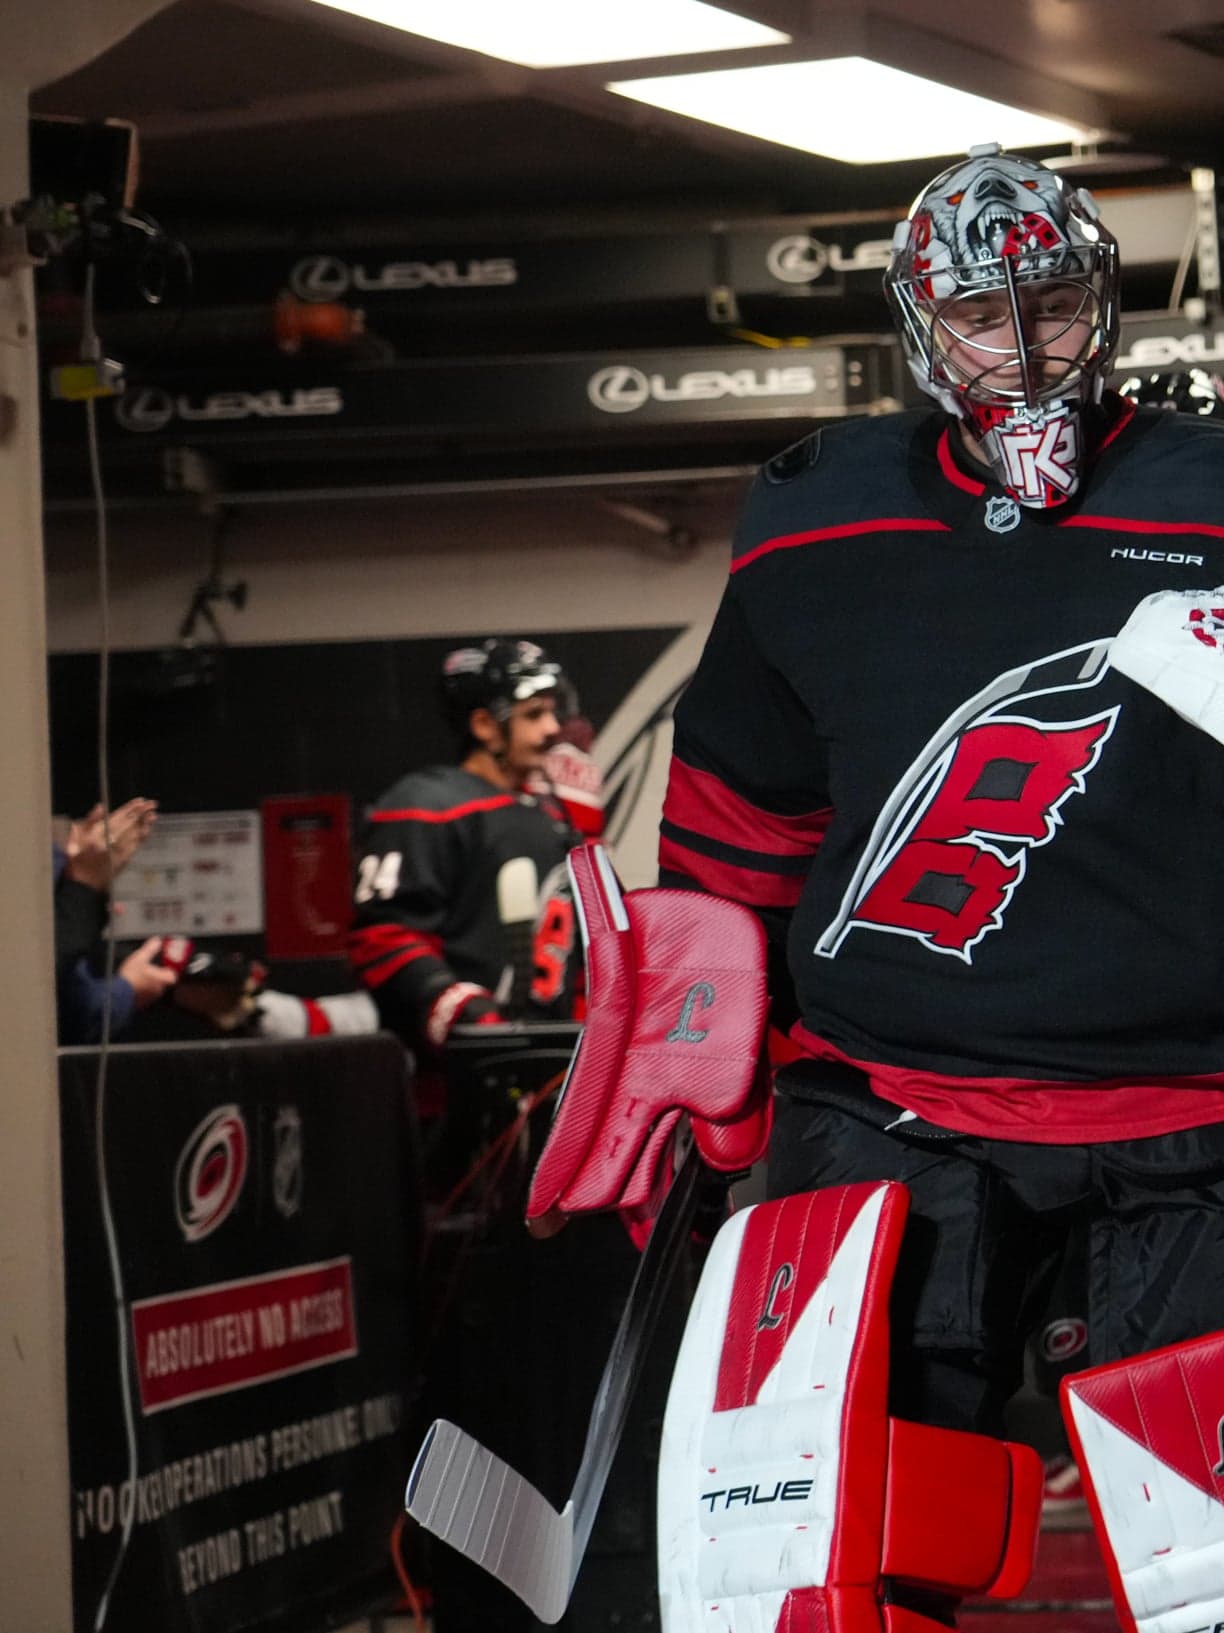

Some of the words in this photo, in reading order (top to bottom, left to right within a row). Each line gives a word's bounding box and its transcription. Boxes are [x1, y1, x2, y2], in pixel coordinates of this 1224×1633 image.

[352, 257, 519, 291] LEXUS
[651, 365, 816, 402] LEXUS
[177, 385, 345, 422] LEXUS
[1110, 548, 1204, 567] NUCOR
[144, 1308, 254, 1380] ABSOLUTELY
[257, 1303, 287, 1350] NO
[164, 1434, 267, 1513] OPERATIONS
[700, 1479, 814, 1512] TRUE
[177, 1528, 242, 1596] BEYOND
[244, 1511, 286, 1568] THIS
[287, 1490, 343, 1550] POINT
